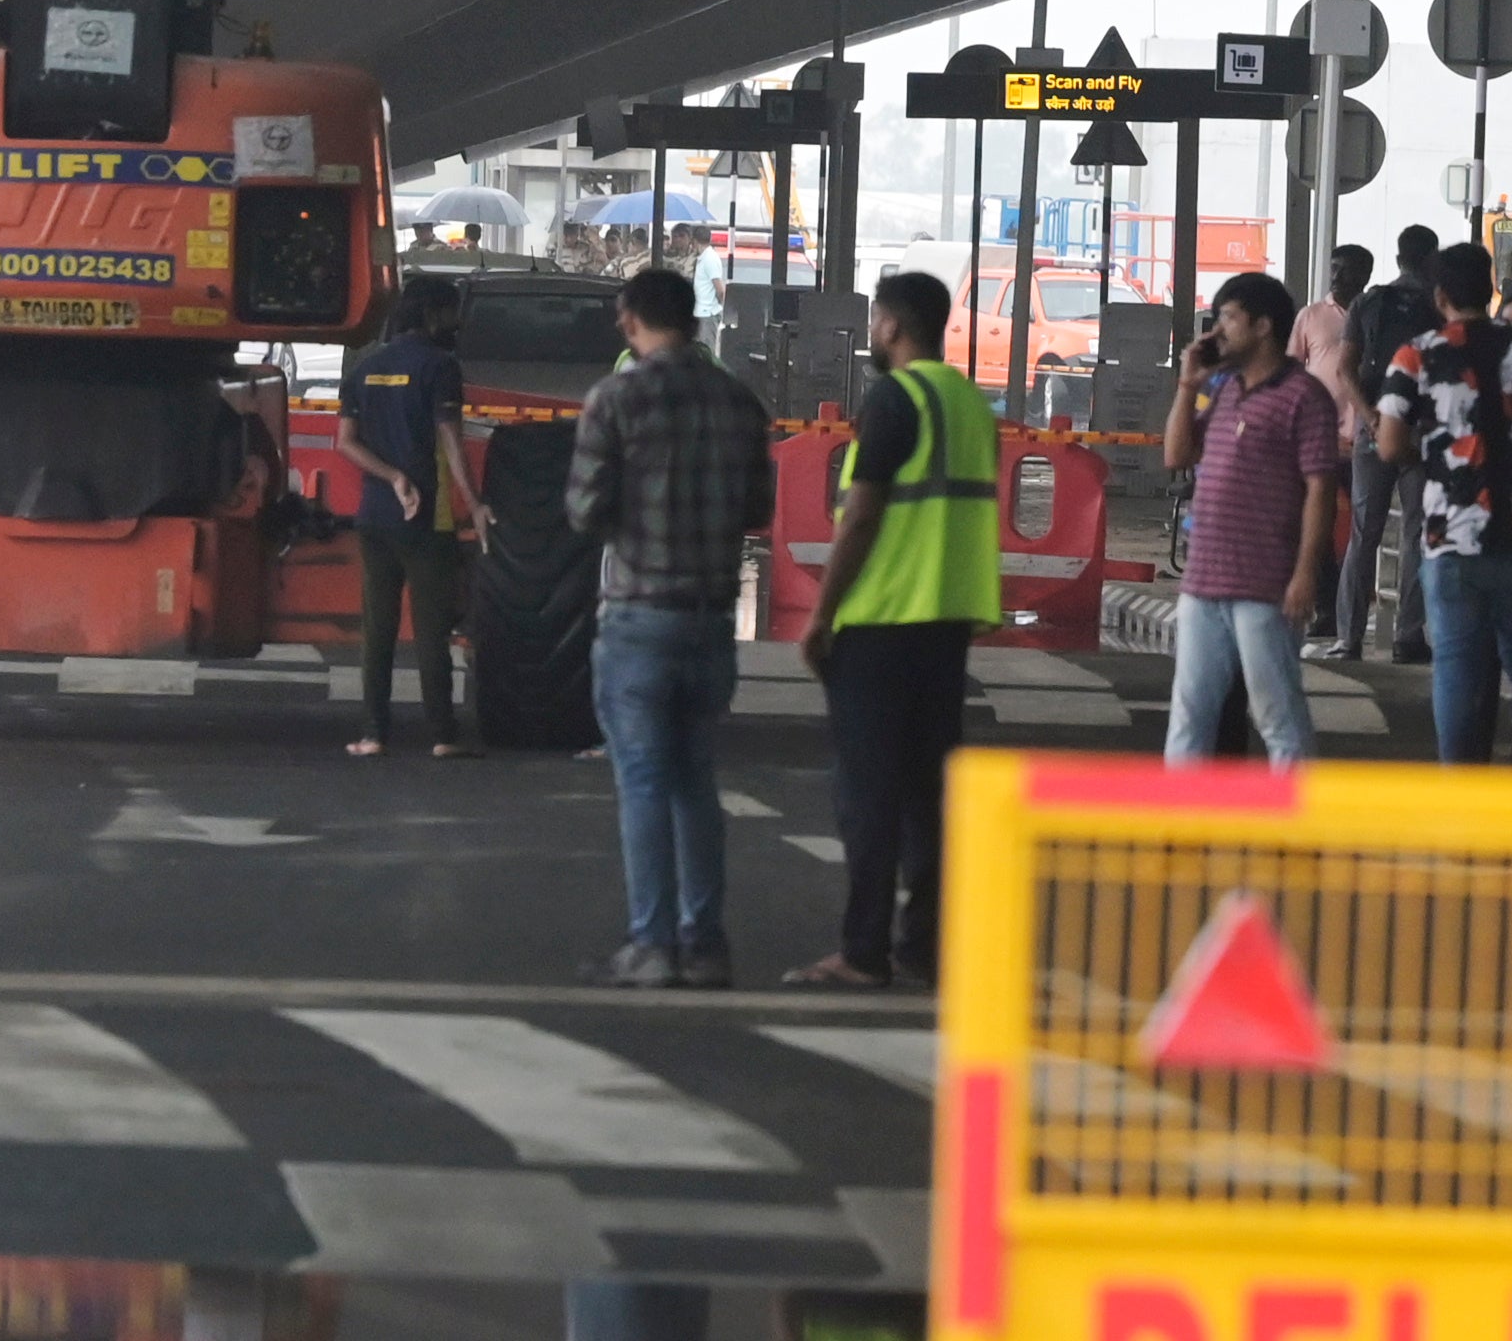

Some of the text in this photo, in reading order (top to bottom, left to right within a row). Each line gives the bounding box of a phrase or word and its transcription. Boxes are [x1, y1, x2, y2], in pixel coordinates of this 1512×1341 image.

[1045, 74, 1143, 94] Scan and Fly
[1072, 95, 1092, 110] और
[20, 300, 96, 325] TOUBRO
[100, 302, 135, 326] LTD
